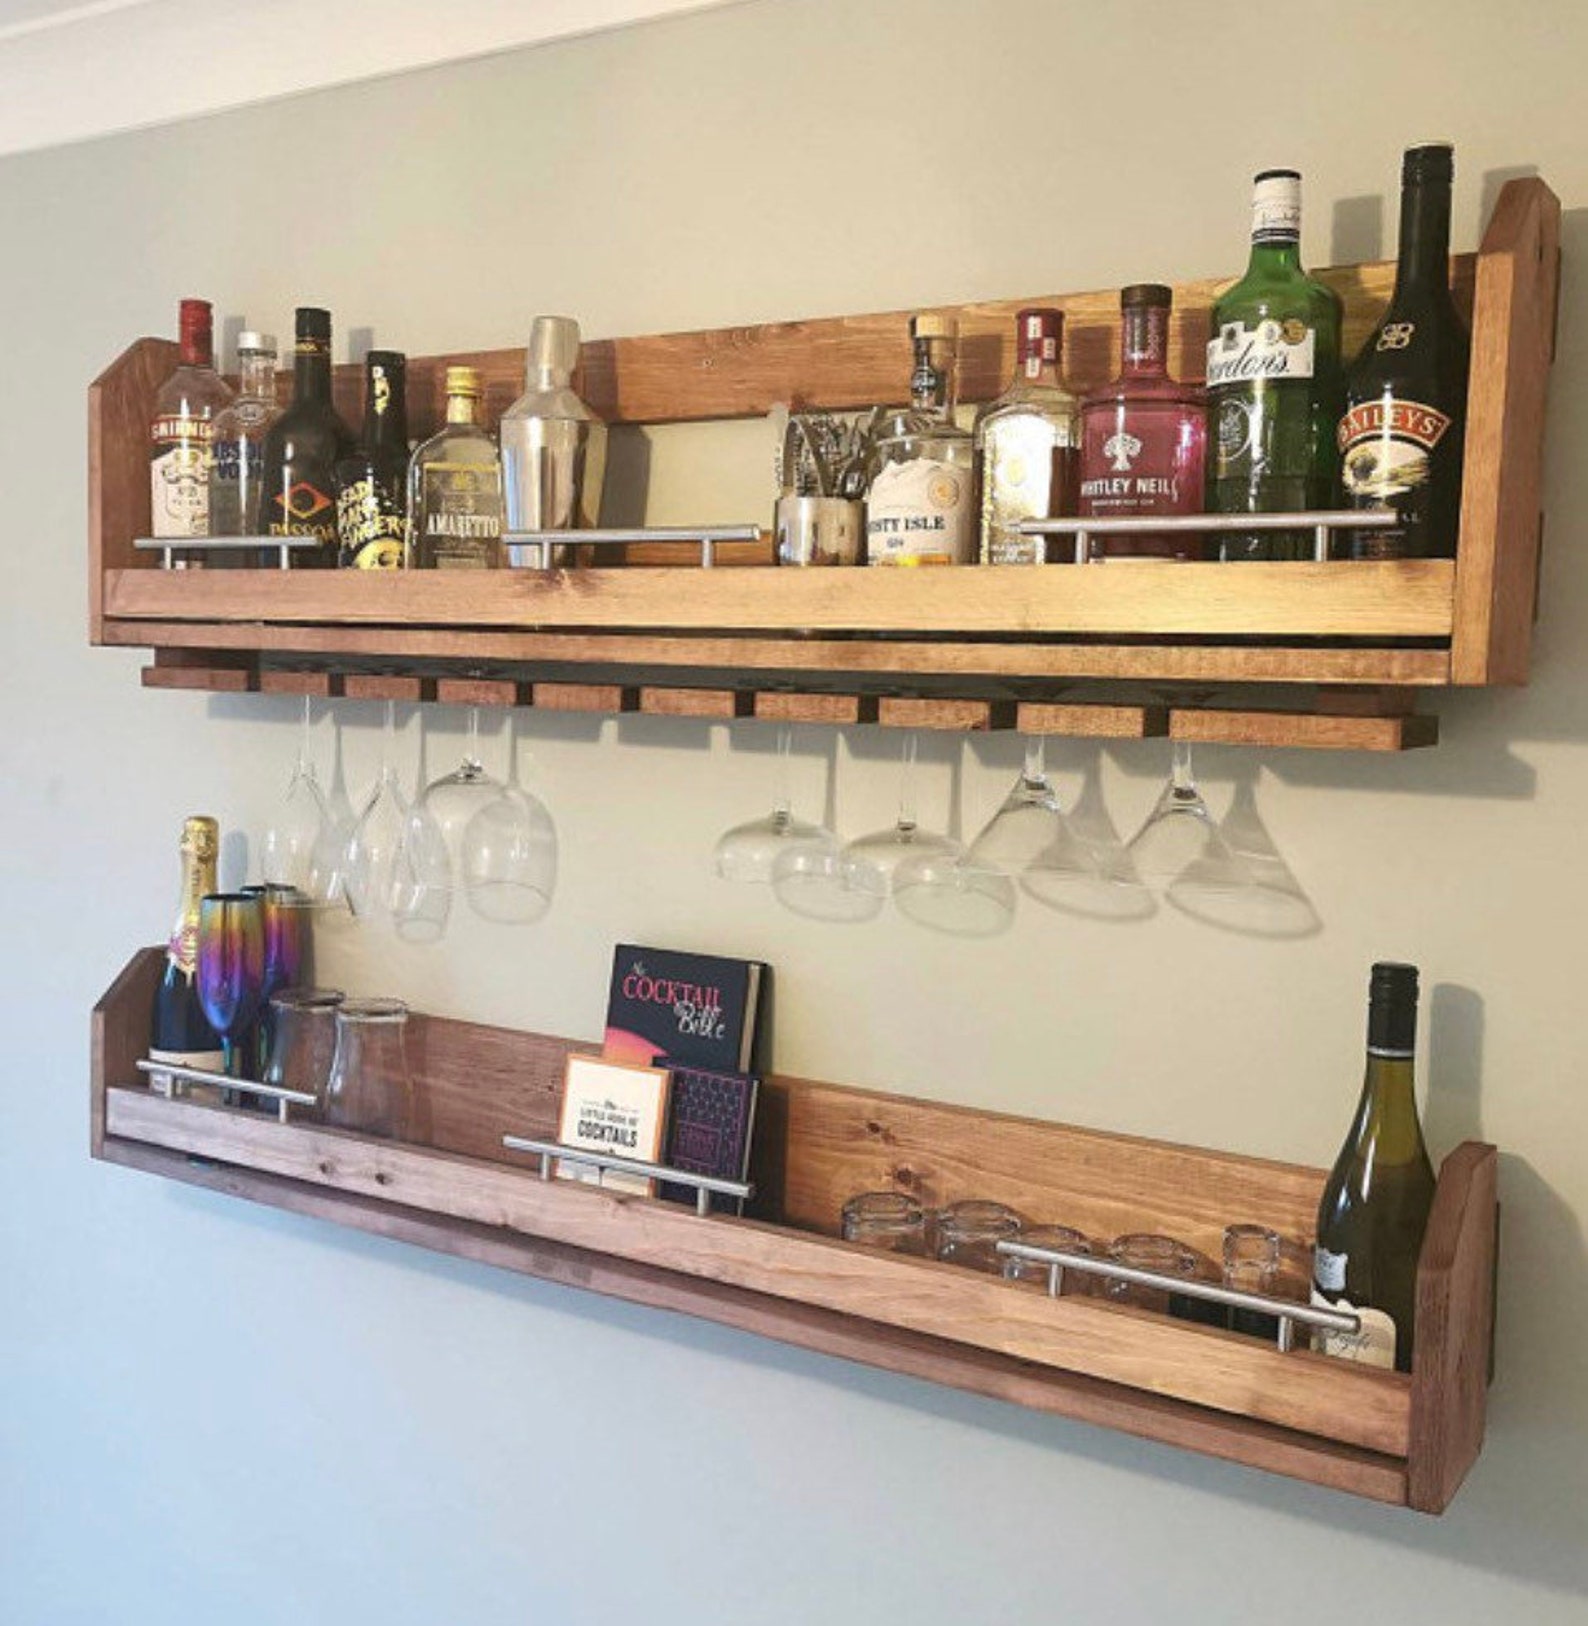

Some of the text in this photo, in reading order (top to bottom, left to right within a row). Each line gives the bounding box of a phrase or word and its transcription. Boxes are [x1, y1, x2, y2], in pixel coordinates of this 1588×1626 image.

[1339, 402, 1438, 444] BAILEYS
[426, 512, 499, 538] AMARETTO
[904, 515, 946, 532] ISLE
[622, 974, 721, 1011] COCKTAIL
[577, 1119, 638, 1149] COCKTAILS
